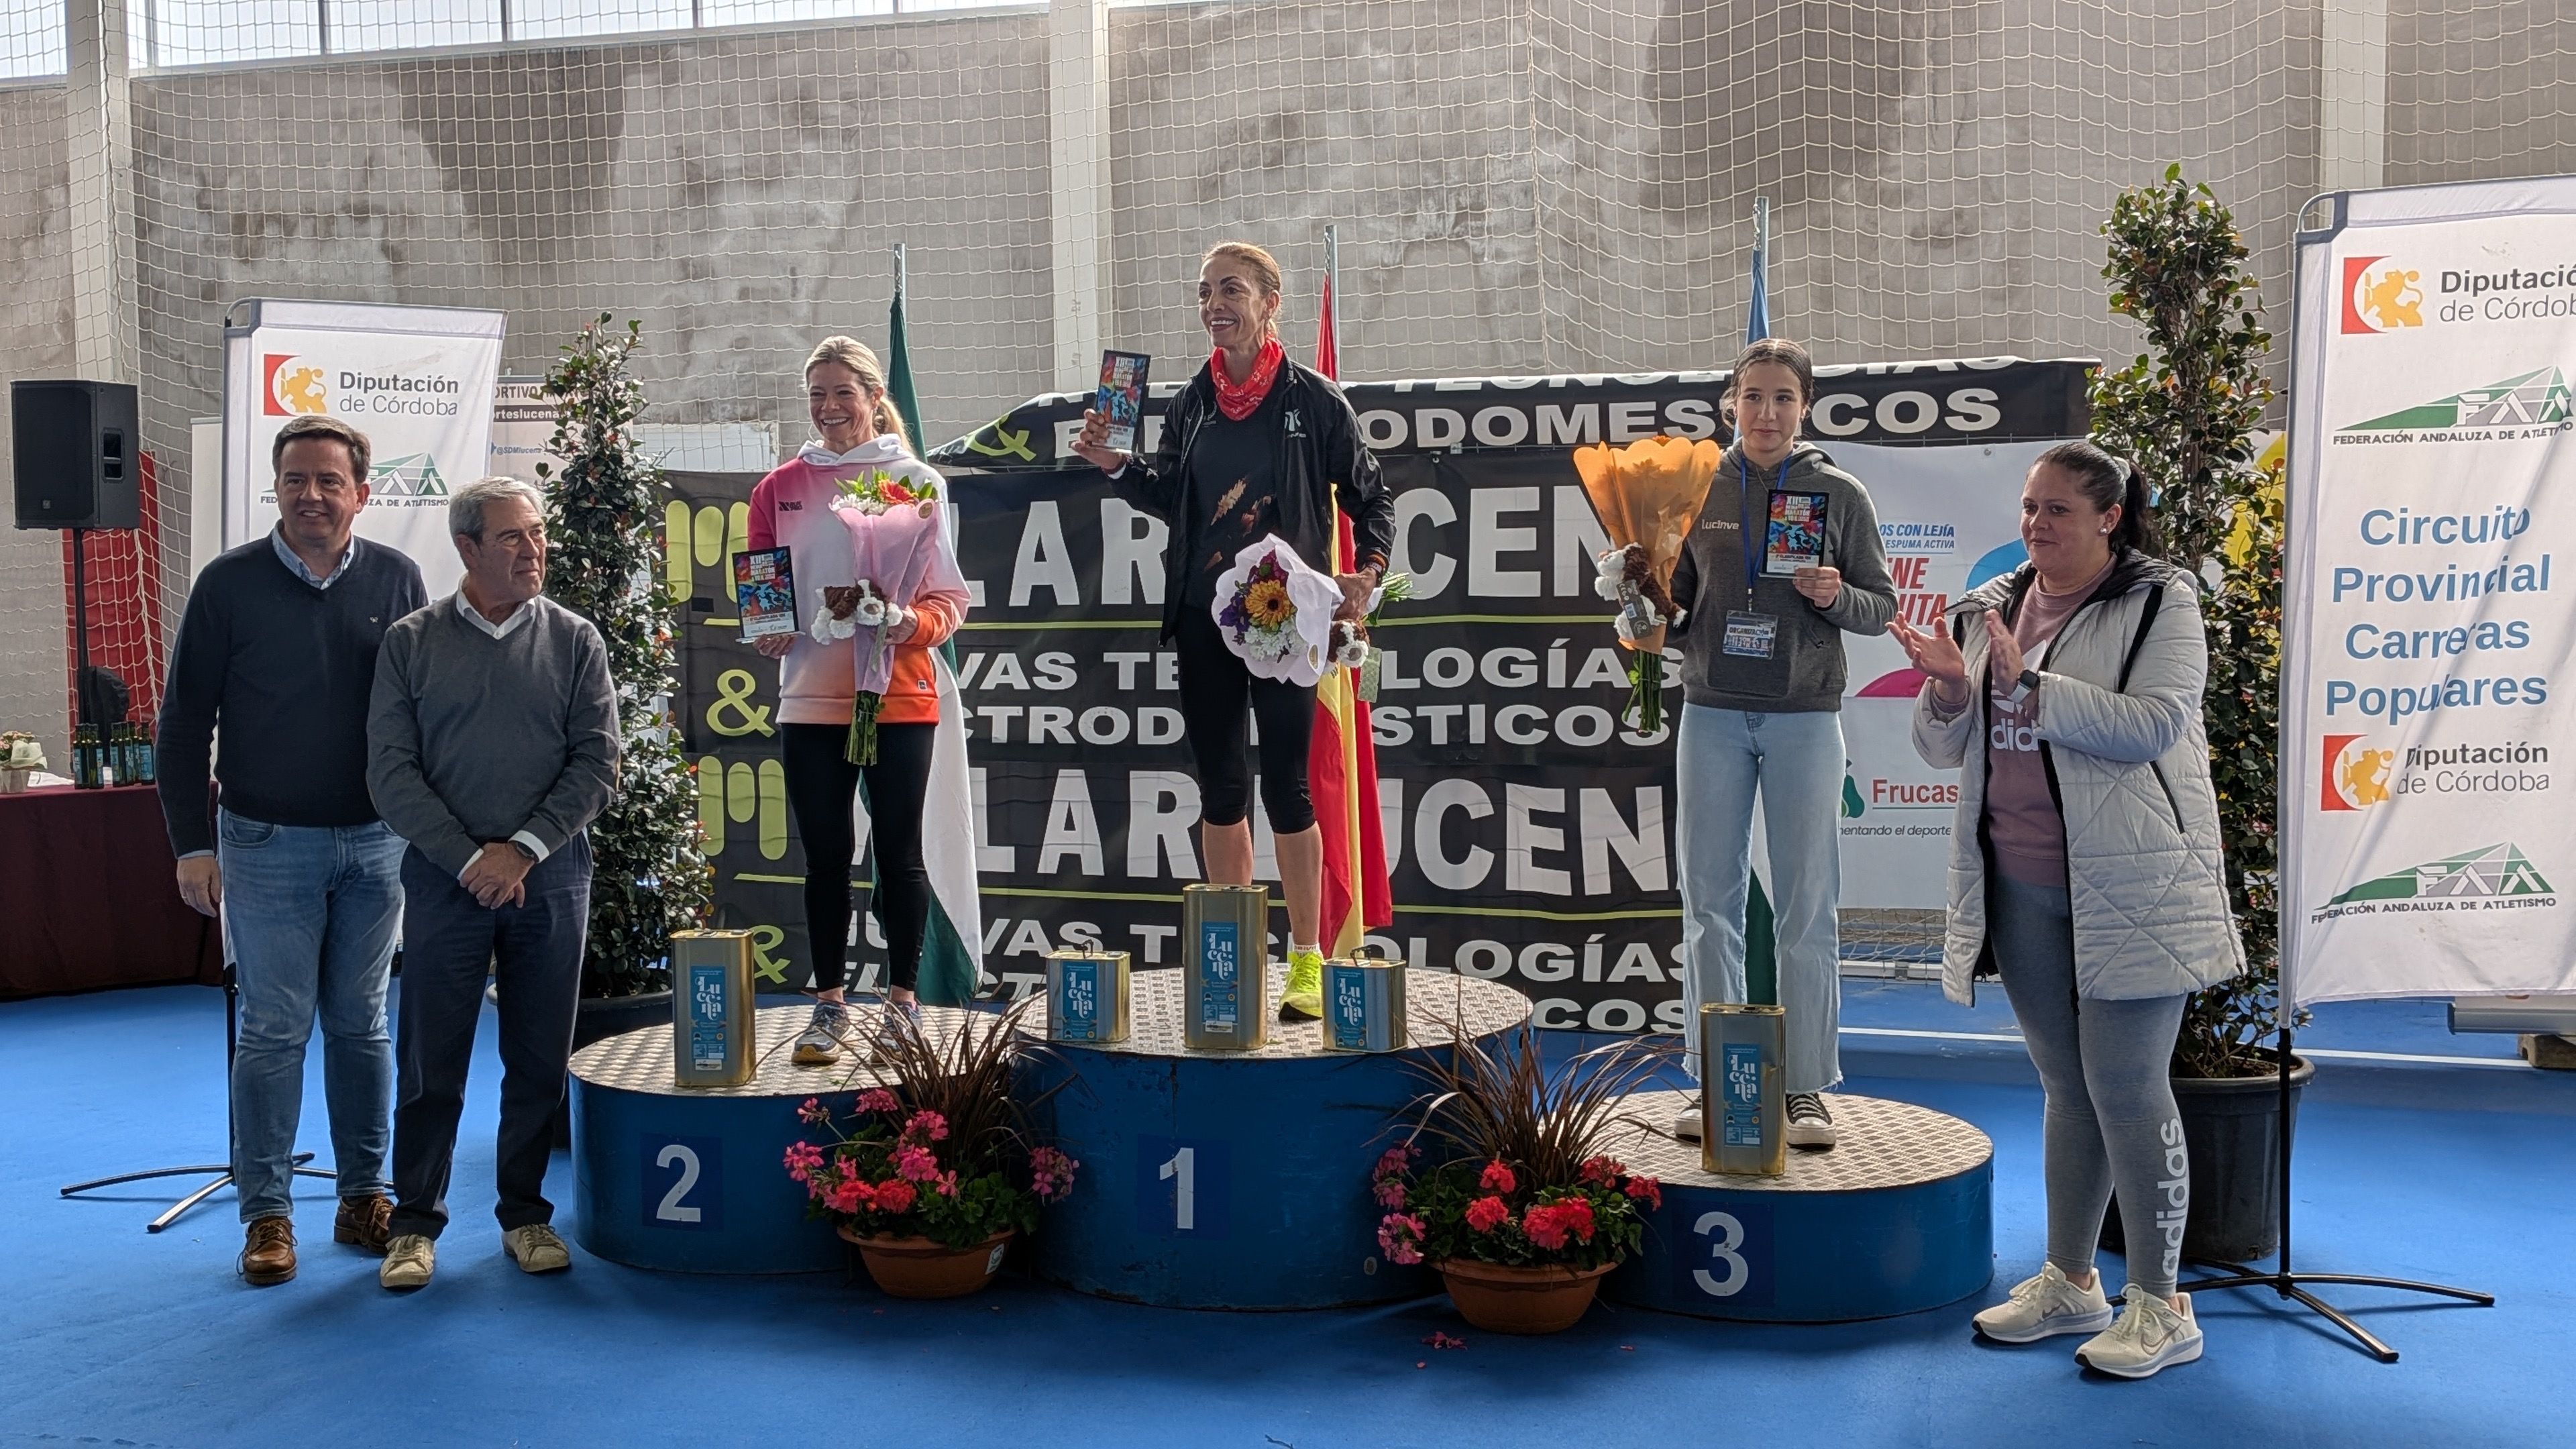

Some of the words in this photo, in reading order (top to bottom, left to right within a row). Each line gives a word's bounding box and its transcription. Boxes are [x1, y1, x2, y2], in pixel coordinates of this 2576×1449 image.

[2439, 299, 2474, 322] de
[339, 371, 459, 394] Diputación
[339, 394, 366, 413] de
[372, 394, 458, 416] Córdoba
[494, 408, 559, 419] rteslucena
[2332, 430, 2414, 445] FEDERACIÓN
[2418, 431, 2493, 443] ANDALUZA
[2498, 430, 2516, 440] DE
[386, 498, 400, 507] DE
[1896, 524, 1922, 537] CON
[1923, 523, 1955, 537] LEJÍA
[2360, 505, 2530, 546] Circuito
[1886, 539, 1922, 549] ESPUMA
[1923, 539, 1955, 549] ACTIVA
[2332, 554, 2551, 603] Provincial
[2345, 620, 2530, 659] Carreras
[706, 669, 776, 738] &
[2326, 674, 2548, 725] Populares
[2398, 773, 2426, 794] de
[2436, 769, 2550, 794] Córdoba
[1894, 825, 1905, 836] el
[2312, 902, 2376, 924] FEDERACIÓN
[2382, 901, 2455, 912] ANDALUZA
[2461, 901, 2477, 910] DE
[2483, 897, 2557, 910] ATLETISMO
[656, 1144, 701, 1223] 2
[1159, 1147, 1194, 1230] 1
[2155, 1117, 2189, 1278] adidas
[1693, 1211, 1748, 1297] 3
